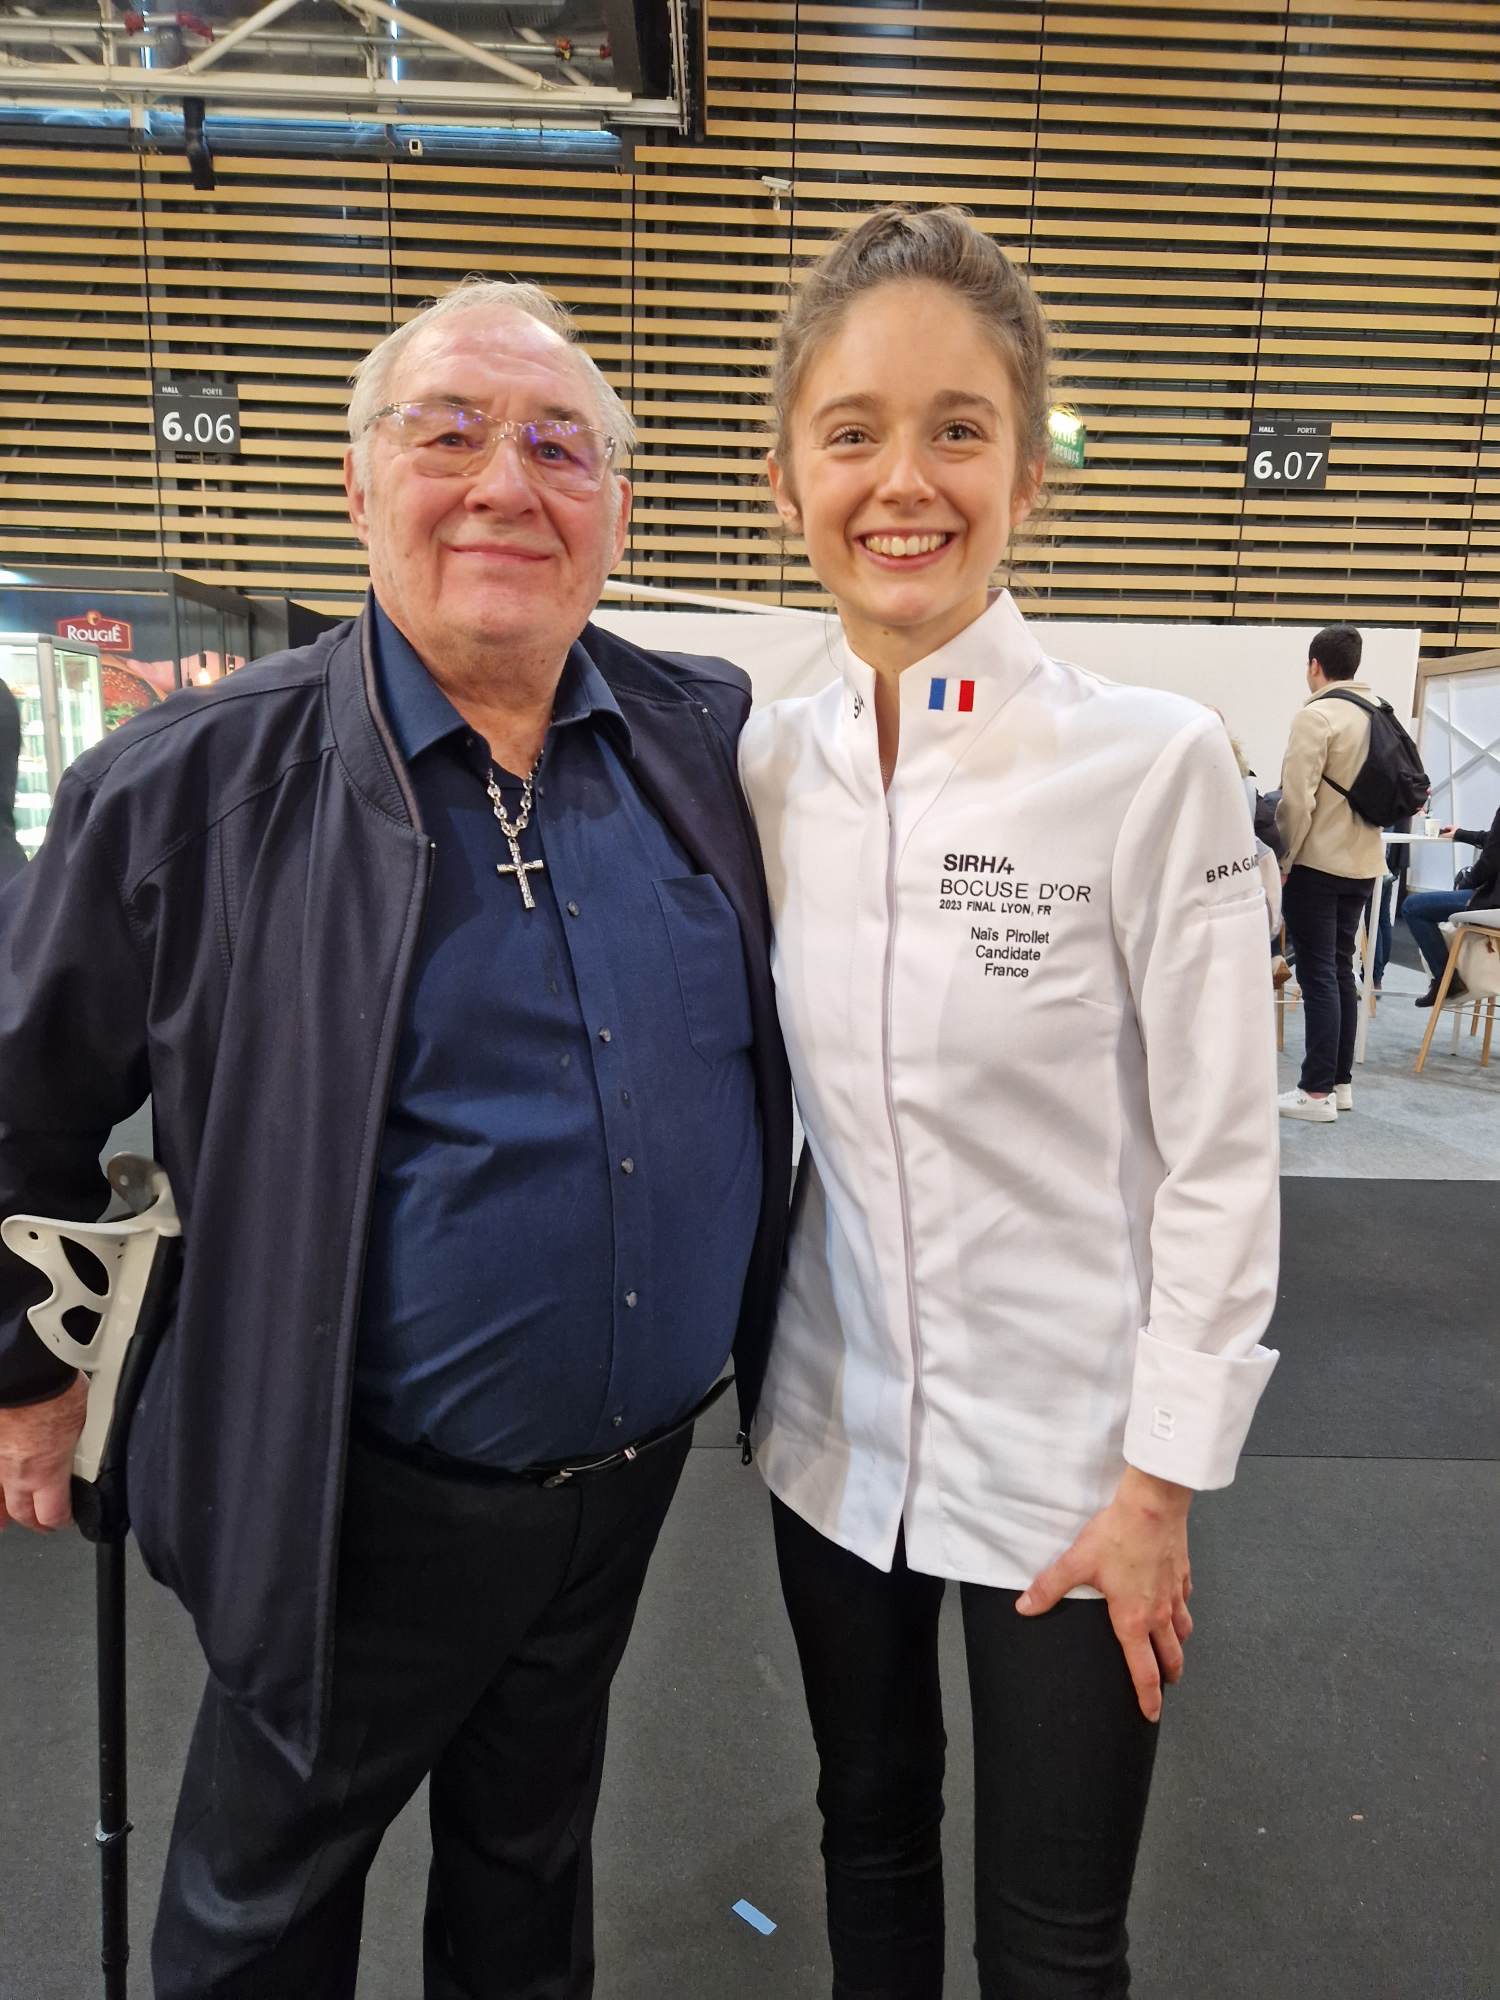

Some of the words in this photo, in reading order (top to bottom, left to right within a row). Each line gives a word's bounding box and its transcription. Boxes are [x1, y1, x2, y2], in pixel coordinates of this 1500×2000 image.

[161, 386, 179, 394] HALL
[202, 388, 223, 396] PORTE
[162, 411, 235, 444] 6.06
[1253, 450, 1324, 480] 6.07
[940, 878, 1029, 899] BOCUSE
[1039, 883, 1092, 903] D'OR
[939, 899, 962, 910] 2023
[967, 901, 996, 912] FINAL
[1001, 903, 1034, 916] LYON,
[1037, 905, 1052, 915] FR
[971, 926, 999, 941] Naïs
[1006, 928, 1050, 944] Pirollet
[975, 945, 1041, 961] Candidate
[984, 963, 1029, 977] France
